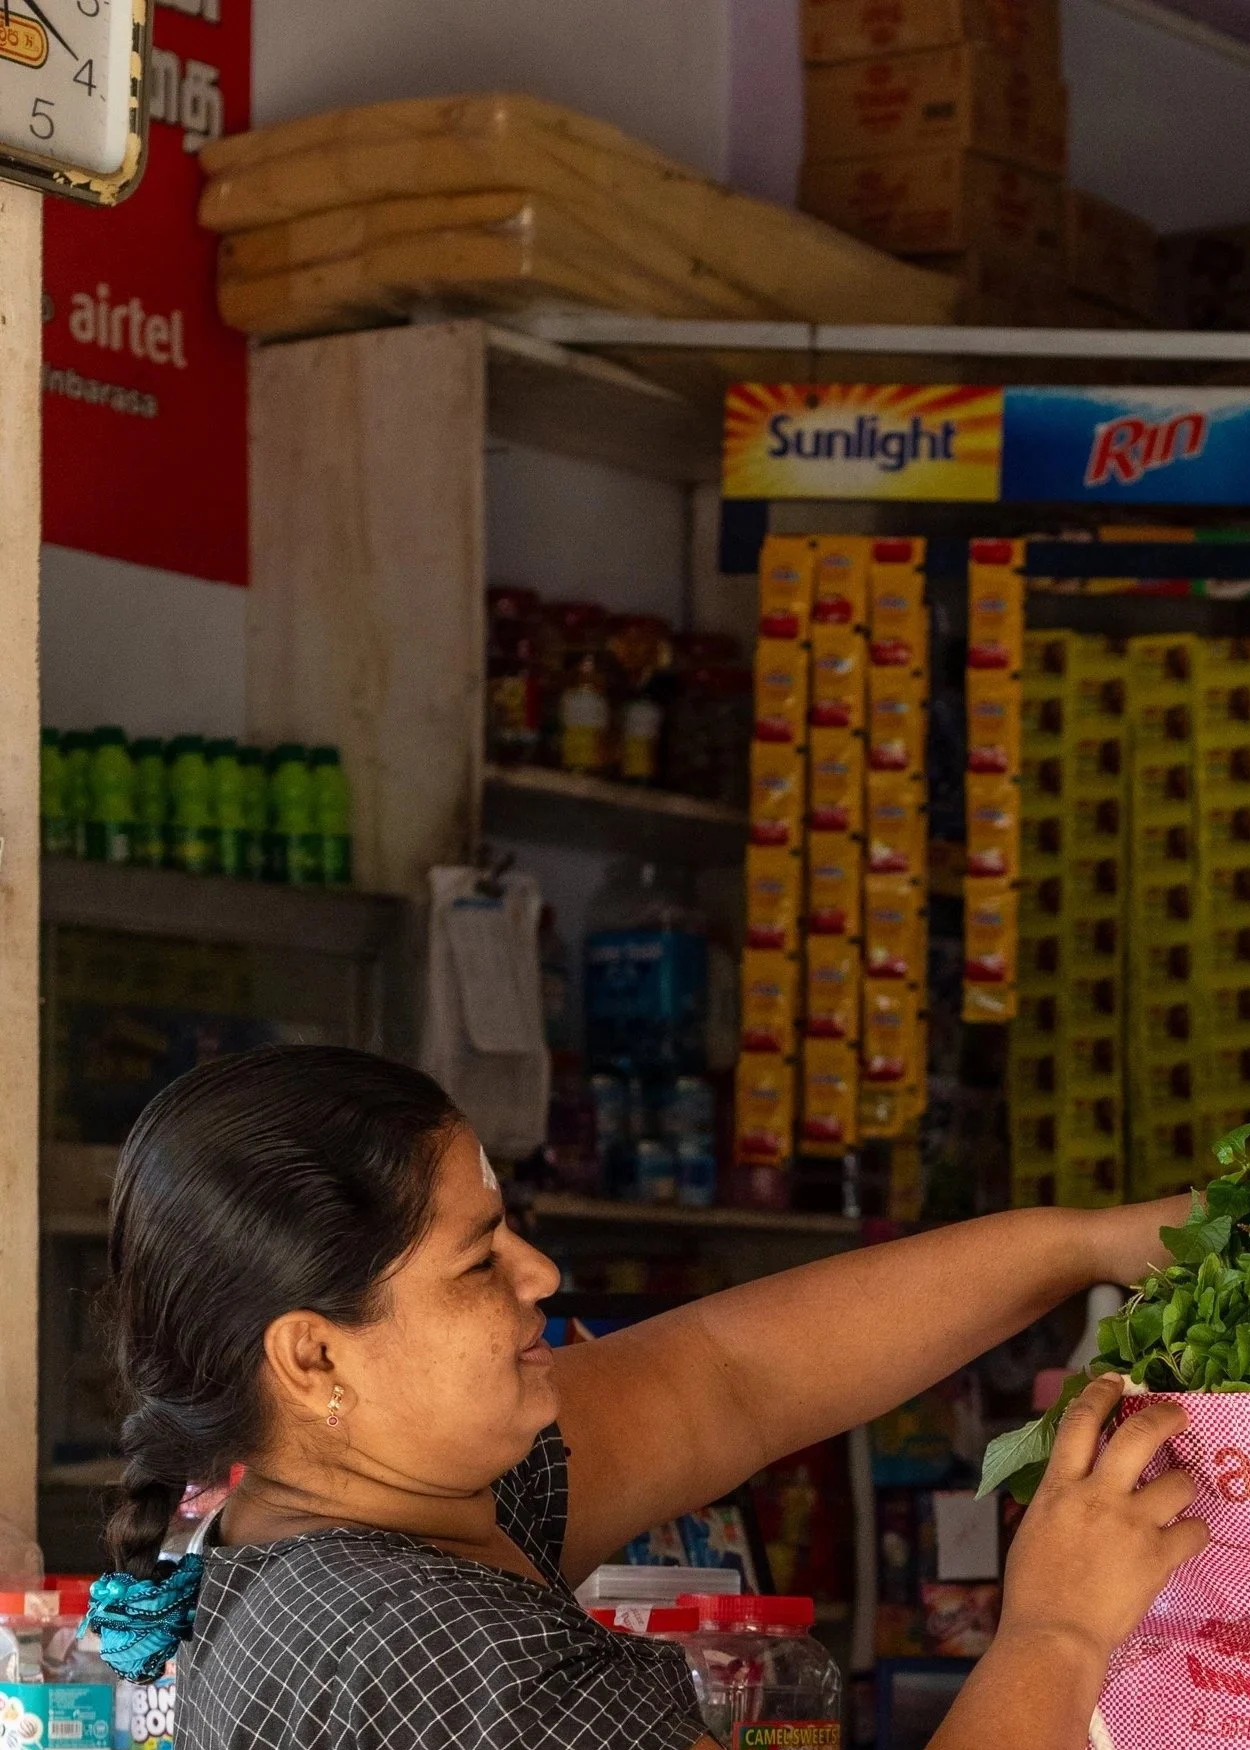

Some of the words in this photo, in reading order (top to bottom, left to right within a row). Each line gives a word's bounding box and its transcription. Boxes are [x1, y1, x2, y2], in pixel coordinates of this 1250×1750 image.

[73, 58, 96, 97] 4
[29, 97, 55, 141] 5
[68, 281, 189, 371] airtel
[767, 413, 956, 472] Sunlight
[745, 1728, 790, 1746] CAMEL
[792, 1727, 838, 1745] SWEETS
